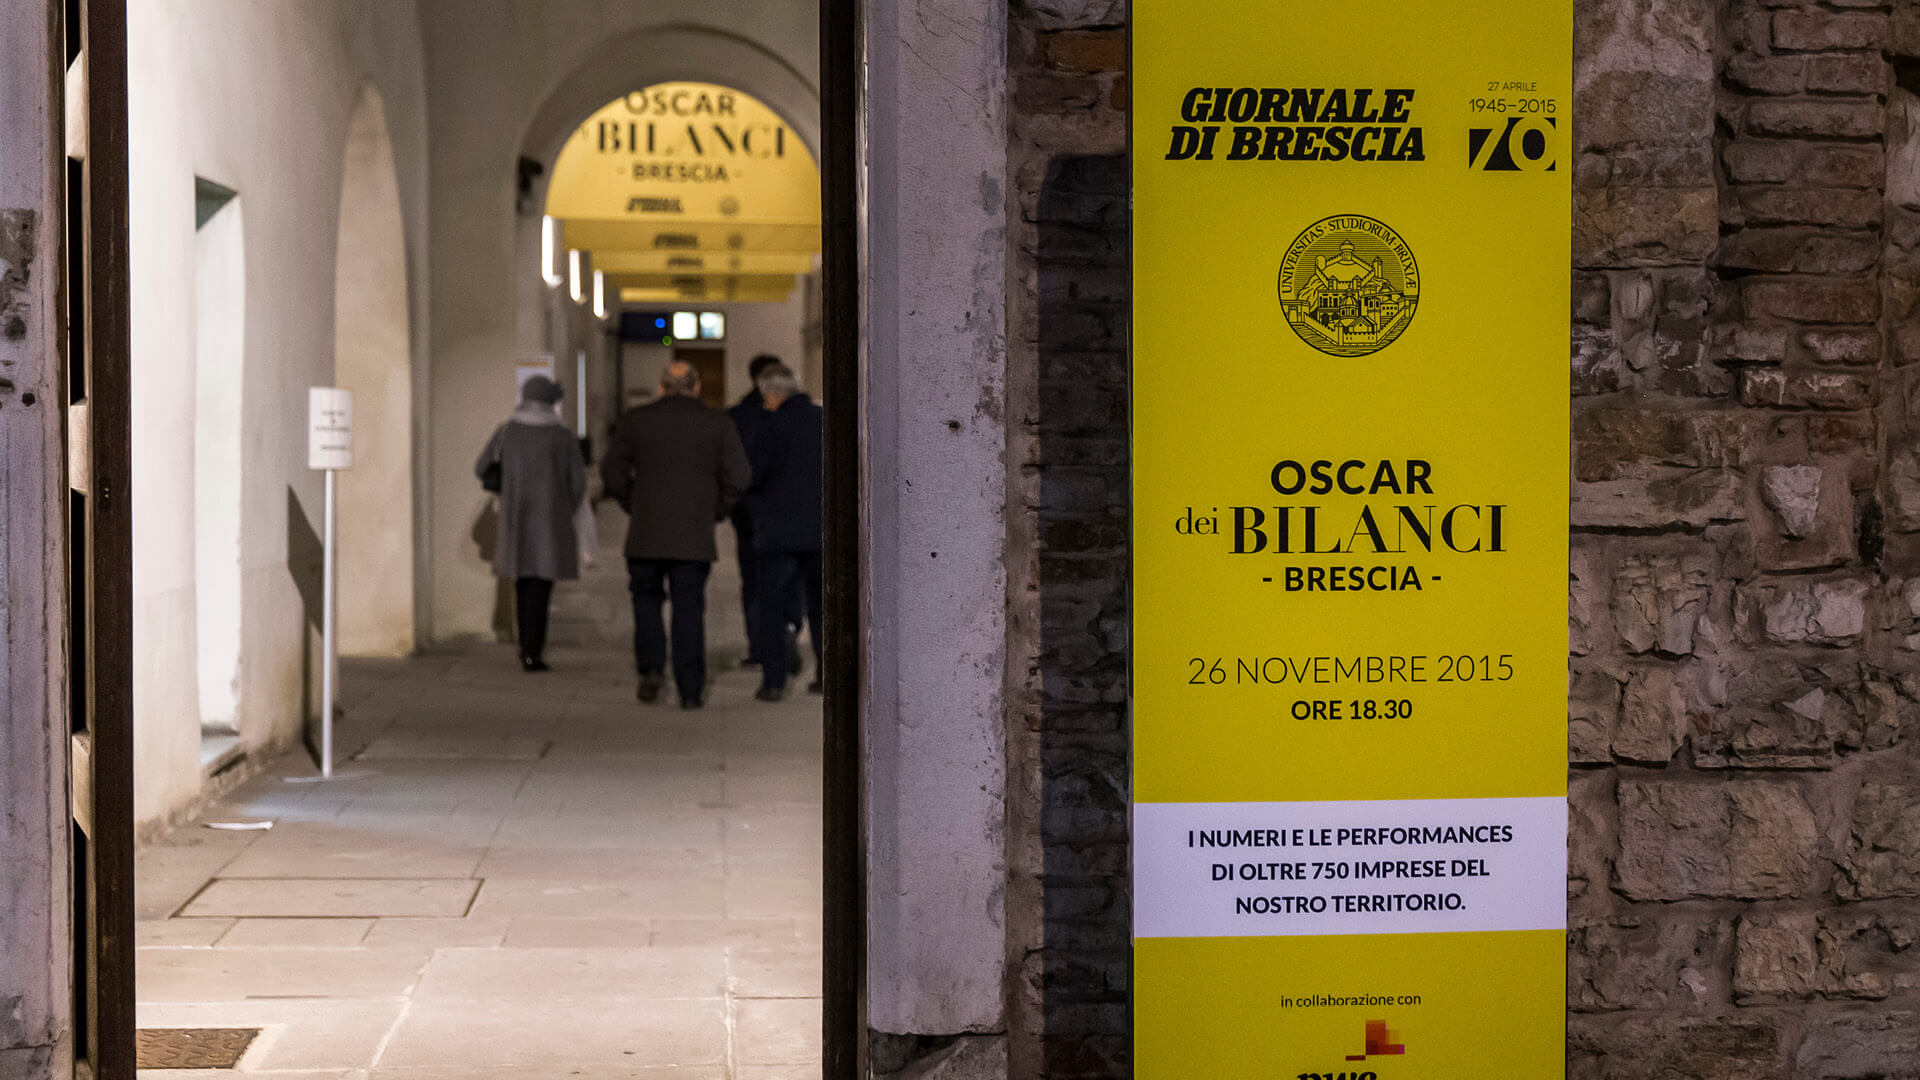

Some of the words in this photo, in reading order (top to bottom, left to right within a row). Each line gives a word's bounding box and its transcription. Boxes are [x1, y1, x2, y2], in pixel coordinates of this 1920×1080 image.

[1487, 81, 1500, 92] 27
[1502, 81, 1537, 92] APRILE
[625, 90, 735, 117] OSCAR
[1181, 87, 1415, 124] GIORNALE
[597, 122, 786, 158] BILANCI
[1165, 126, 1220, 161] DI
[1226, 126, 1426, 162] BRESCIA
[1468, 116, 1557, 172] 70
[632, 163, 729, 182] BRESCIA
[1282, 225, 1325, 294] UNIVERSITAS
[1328, 217, 1395, 246] STUDIORUM
[1270, 459, 1434, 496] OSCAR
[1175, 506, 1220, 535] dei
[1228, 504, 1508, 555] BILANCI
[1285, 565, 1423, 592] BRESCIA
[1187, 657, 1227, 685] 26
[1237, 655, 1428, 685] NOVEMBRE
[1437, 654, 1514, 682] 2015
[1290, 699, 1343, 721] ORE
[1349, 699, 1413, 720] 18.30
[1188, 830, 1194, 848] I
[1199, 829, 1287, 848] NUMERI
[1292, 829, 1304, 847] E
[1309, 828, 1332, 847] LE
[1337, 825, 1513, 847] PERFORMANCES
[1211, 863, 1234, 881] DI
[1239, 862, 1307, 881] OLTRE
[1311, 861, 1350, 880] 750
[1354, 859, 1446, 879] IMPRESE
[1451, 859, 1490, 877] DEL
[1236, 895, 1327, 915] NOSTRO
[1331, 892, 1466, 914] TERRITORIO.
[1280, 994, 1293, 1009] in
[1295, 992, 1395, 1008] collaborazione
[1397, 994, 1422, 1006] con
